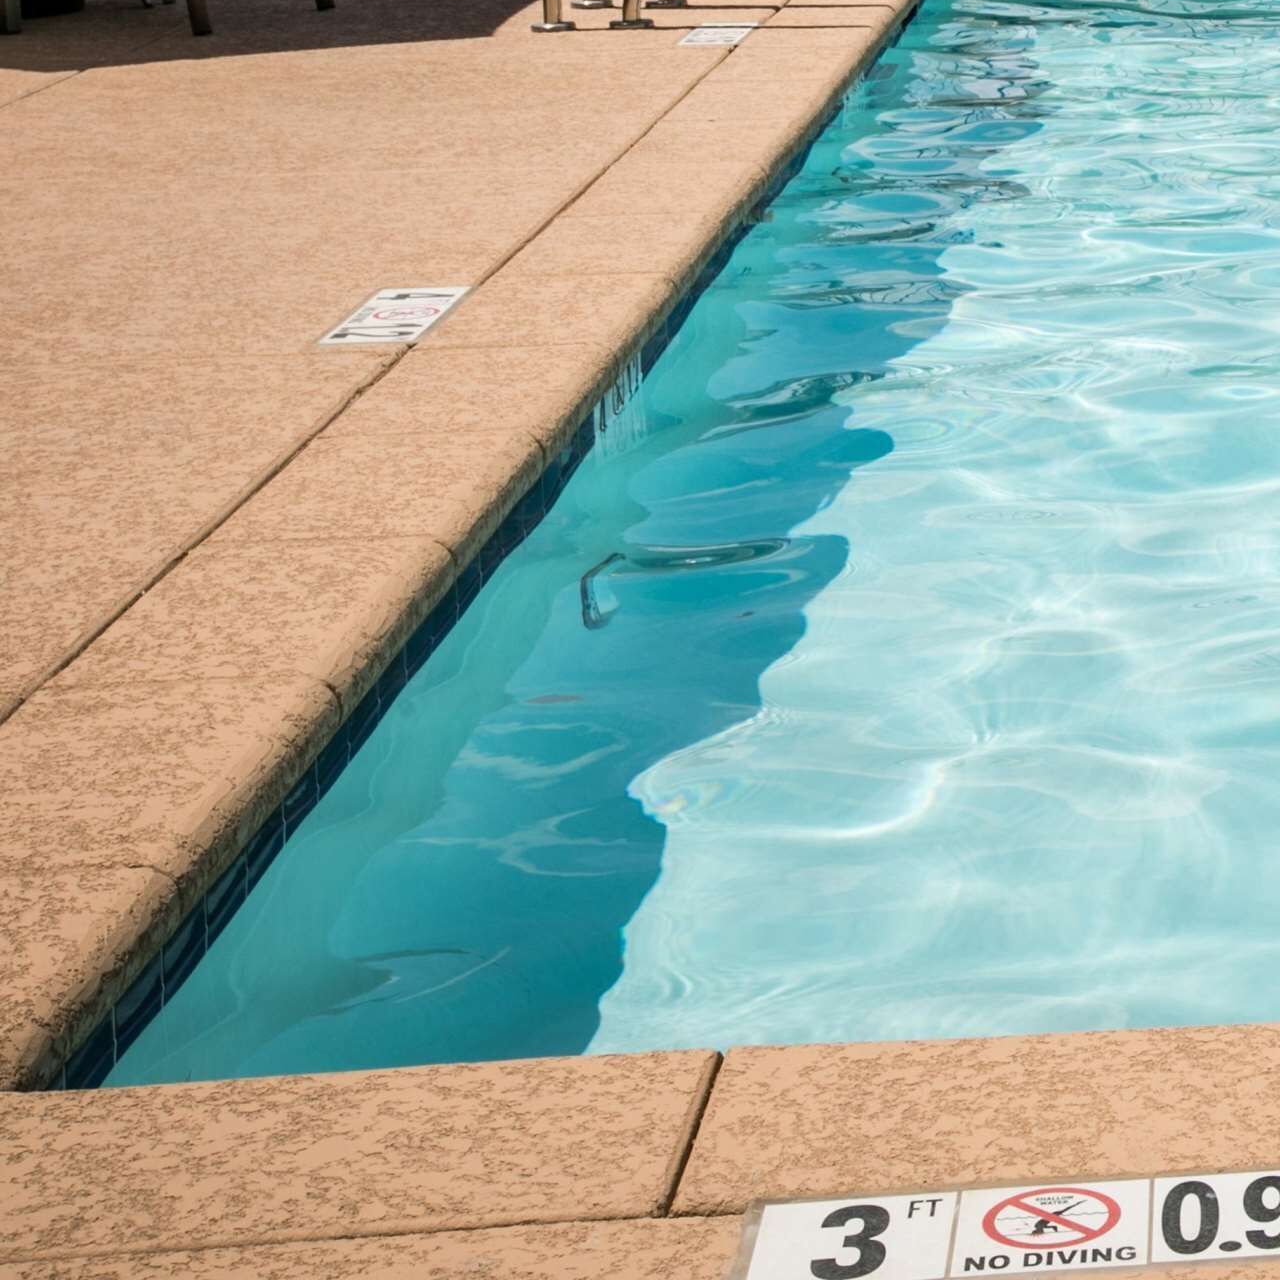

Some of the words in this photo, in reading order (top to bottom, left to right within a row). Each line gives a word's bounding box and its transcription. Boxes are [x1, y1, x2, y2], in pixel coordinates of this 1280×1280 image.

[810, 1204, 890, 1280] 3
[908, 1198, 944, 1219] FT
[963, 1252, 1011, 1273] NO
[1022, 1246, 1137, 1268] DIVING
